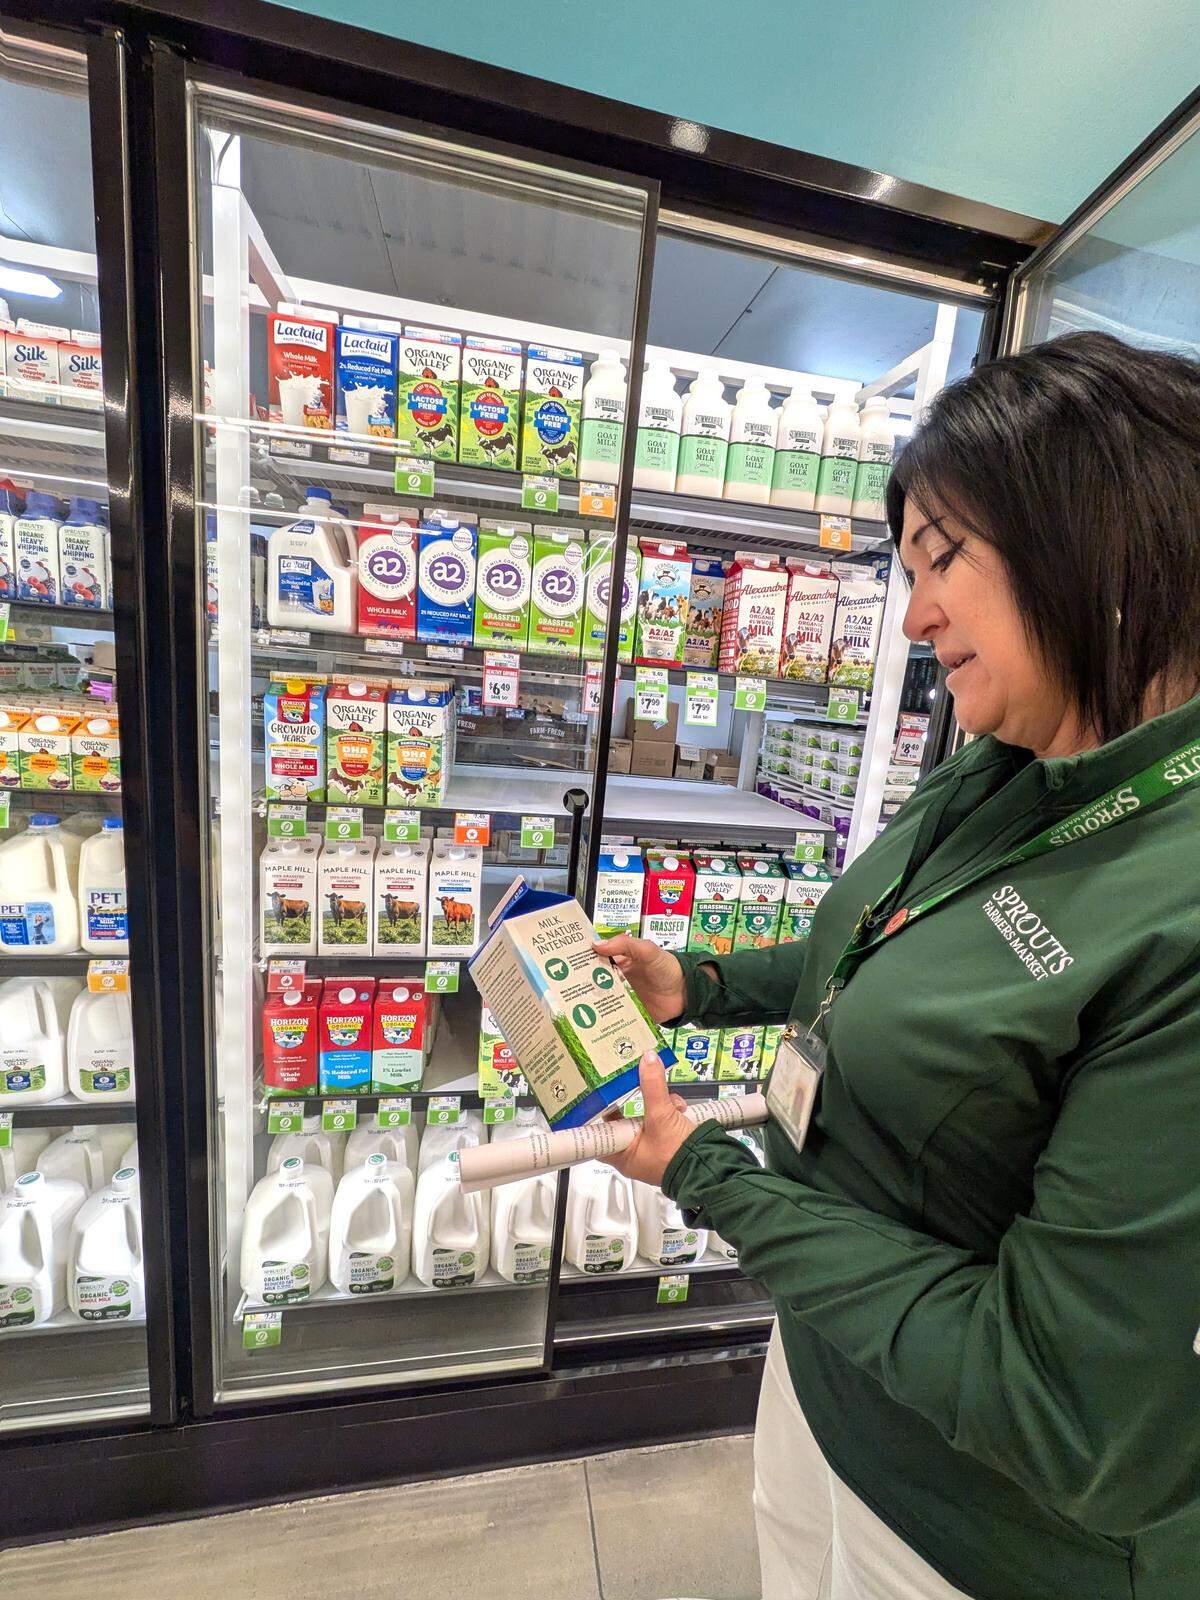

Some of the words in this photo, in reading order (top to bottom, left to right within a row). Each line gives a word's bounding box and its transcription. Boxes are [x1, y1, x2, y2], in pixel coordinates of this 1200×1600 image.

[277, 323, 323, 342] Lactaid
[344, 336, 388, 353] Lactaid
[14, 345, 47, 362] Silk
[283, 352, 303, 361] Whole
[304, 354, 318, 363] Milk
[405, 348, 453, 364] ORGANIC
[69, 355, 100, 372] Silk
[348, 363, 371, 372] Reduced
[372, 366, 380, 374] Fat
[381, 367, 392, 375] Milk
[410, 356, 449, 371] VALLEY
[468, 358, 516, 374] ORGANIC
[472, 366, 511, 381] VALLEY
[533, 367, 578, 384] ORGANIC
[536, 376, 574, 390] VALLEY
[412, 395, 444, 405] LACTOSE
[418, 403, 436, 411] FREE
[474, 404, 505, 414] LACTOSE
[480, 412, 499, 420] FREE
[538, 413, 568, 423] LACTOSE
[597, 432, 618, 440] GOAT
[597, 438, 617, 447] MILK
[647, 440, 667, 448] GOAT
[696, 454, 714, 462] MILK
[745, 455, 764, 463] GOAT
[745, 461, 763, 469] MILK
[789, 468, 808, 476] MILK
[21, 537, 42, 545] HEAVY
[17, 544, 48, 552] WHIPPING
[63, 550, 94, 558] WHIPPING
[373, 556, 402, 577] a2
[434, 562, 461, 582] a2
[490, 570, 517, 589] a2
[546, 576, 571, 595] a2
[740, 582, 789, 596] Alexandre
[791, 590, 837, 601] Alexandre
[837, 594, 885, 606] Alexandre
[750, 606, 776, 615] A2/A2
[484, 612, 520, 622] GRASSFED
[538, 618, 574, 627] GRASSFED
[799, 612, 824, 622] A2/A2
[845, 615, 872, 626] A2/A2
[650, 629, 674, 637] A2/A2
[748, 625, 774, 636] MILK
[686, 638, 710, 646] A2/A2
[796, 632, 821, 643] MILK
[844, 636, 870, 648] MILK
[332, 705, 378, 717] ORGANIC
[393, 710, 437, 722] ORGANIC
[336, 713, 374, 723] VALLEY
[397, 717, 434, 728] VALLEY
[271, 724, 316, 734] GROWING
[458, 720, 476, 730] FRESH
[529, 727, 566, 737] FARM-FRESH
[28, 738, 57, 746] ORGANIC
[31, 742, 55, 750] VALLEY
[80, 741, 110, 749] ORGANIC
[342, 746, 368, 754] DHA
[402, 751, 426, 759] DHA
[1081, 795, 1114, 818] FARMERS
[1050, 787, 1140, 846] SPROUTS
[1051, 815, 1081, 836] MARKET
[797, 887, 824, 895] ORGANIC
[90, 893, 121, 904] PET
[1, 905, 24, 914] PET
[538, 915, 562, 929] MILK
[650, 921, 684, 932] GRASSFED
[532, 934, 545, 946] AS
[546, 922, 582, 940] NATURE
[992, 885, 1074, 975] SPROUTS
[537, 933, 584, 955] INTENDED
[982, 900, 1016, 940] FARMERS
[1010, 937, 1048, 981] MARKET
